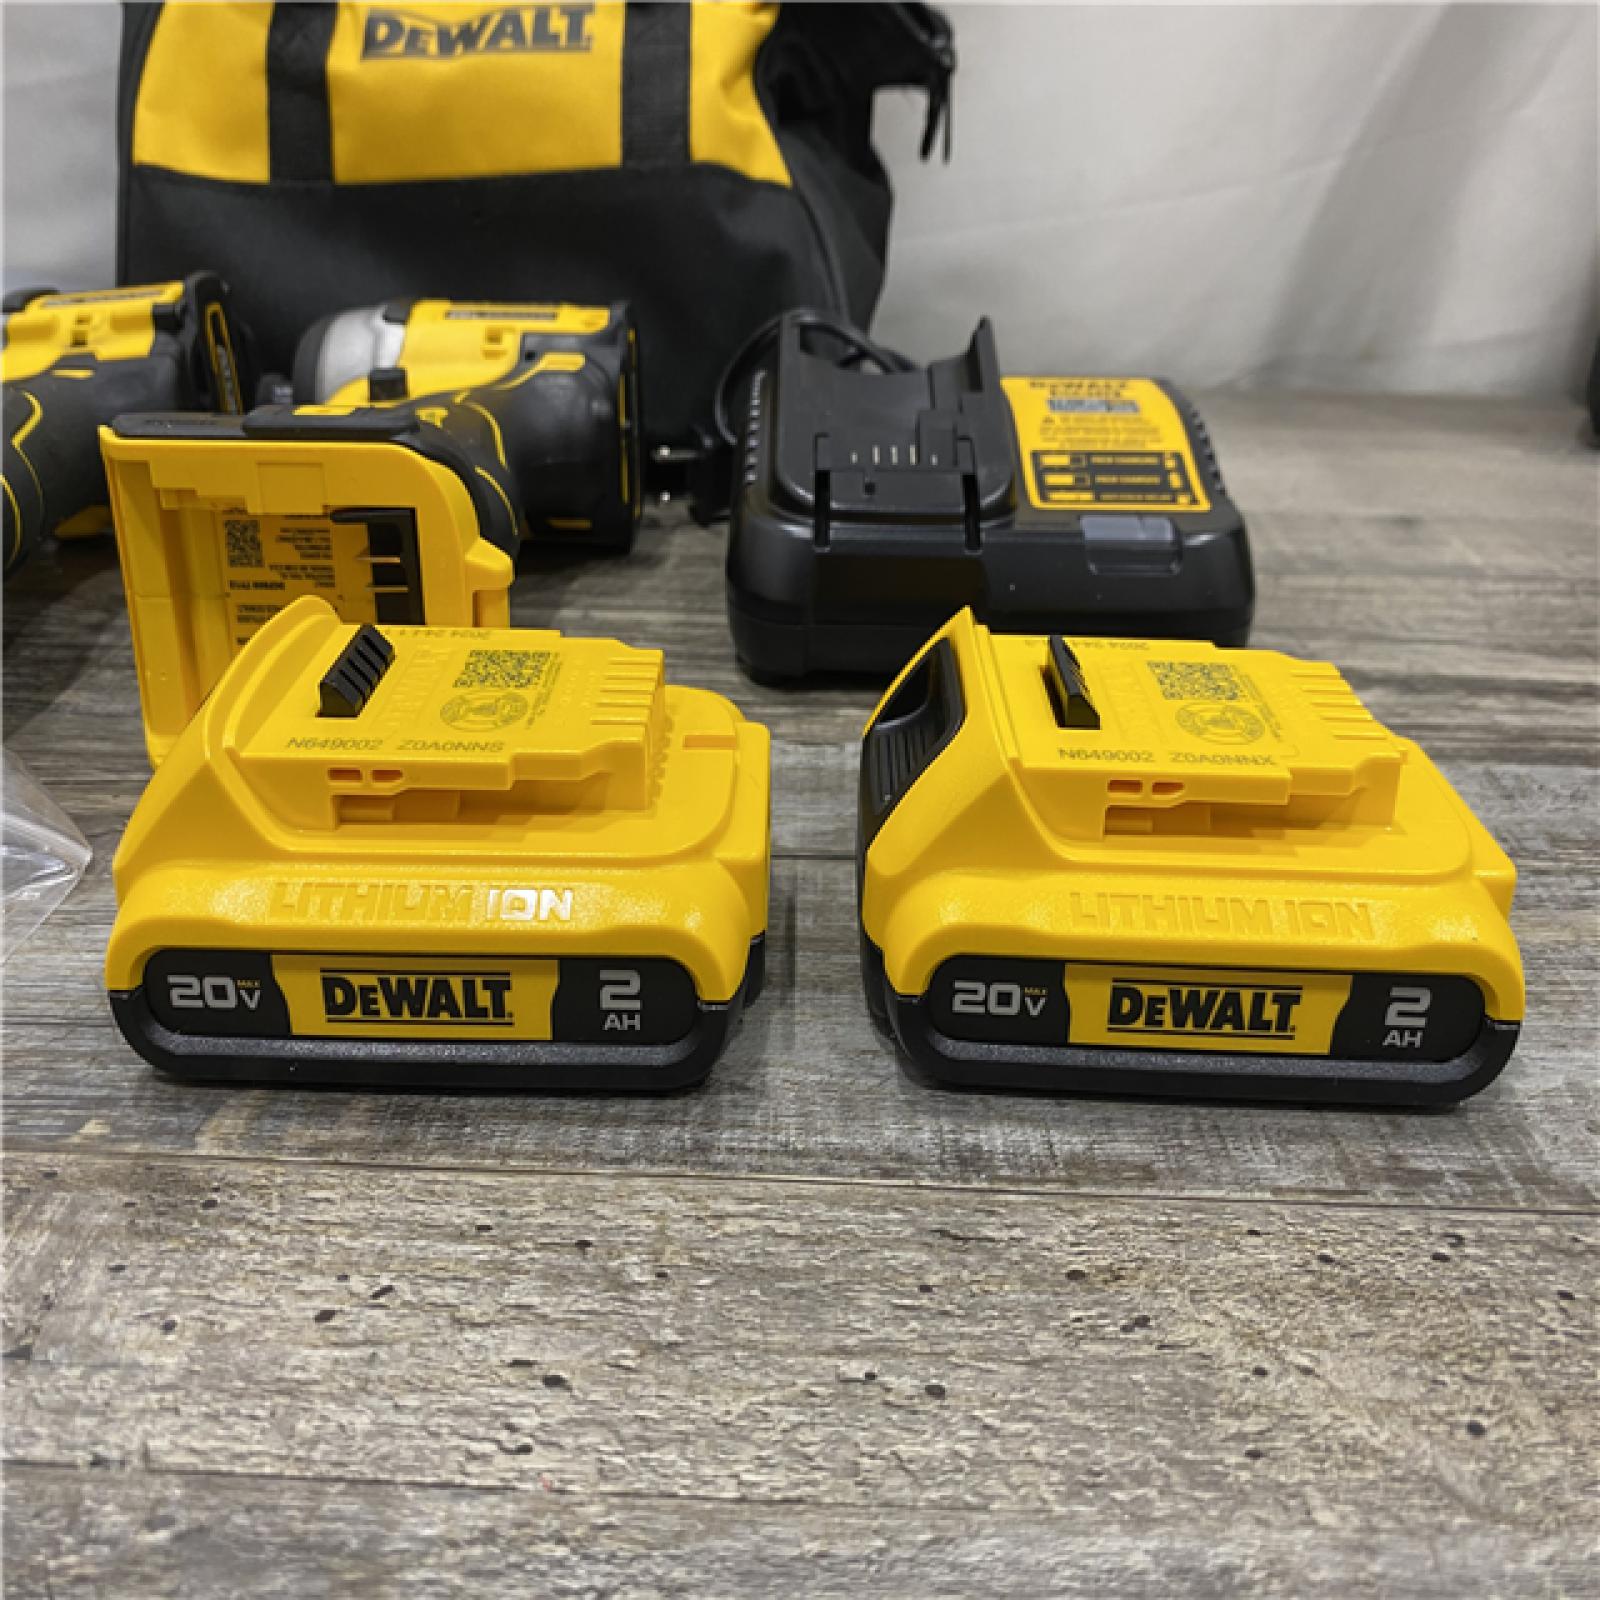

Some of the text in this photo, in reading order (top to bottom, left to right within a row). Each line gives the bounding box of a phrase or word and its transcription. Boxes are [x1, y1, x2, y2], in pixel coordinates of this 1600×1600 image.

[268, 880, 574, 923] LITHIUM ION
[1067, 891, 1375, 940] LITHIUM ION
[599, 969, 642, 1011] 2
[1384, 986, 1432, 1028] 2
[602, 1012, 642, 1032] AH
[1382, 1029, 1422, 1049] AH
